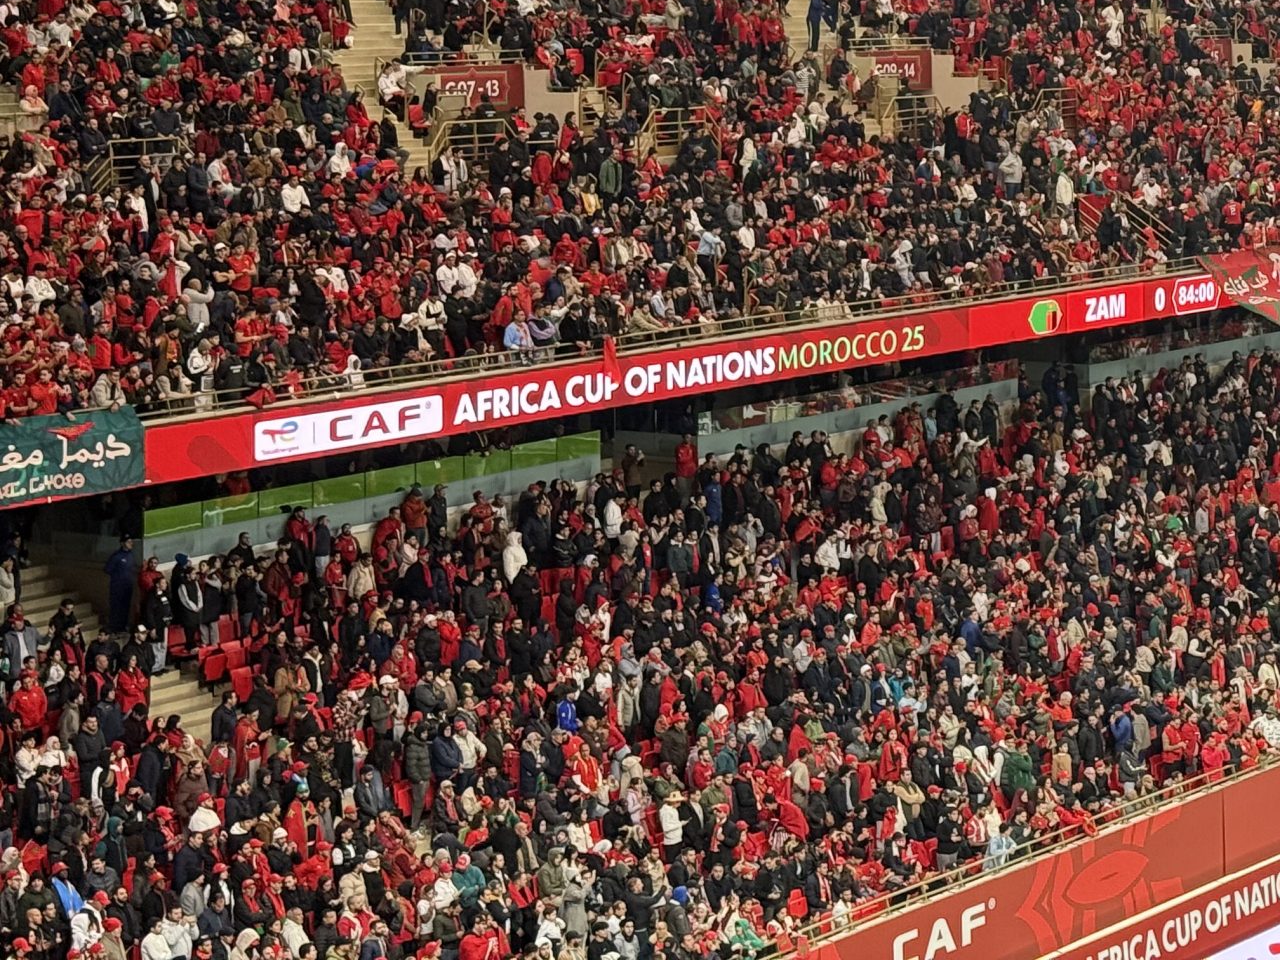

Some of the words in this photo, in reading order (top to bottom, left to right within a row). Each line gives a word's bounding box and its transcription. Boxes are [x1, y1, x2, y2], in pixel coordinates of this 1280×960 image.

[1085, 292, 1126, 323] ZAM
[1154, 287, 1166, 312] 0
[1178, 281, 1215, 306] 84:00
[329, 404, 421, 442] CAF
[453, 380, 562, 425] AFRICA
[624, 363, 662, 397] OF
[665, 346, 776, 391] NATIONS
[777, 329, 898, 372] MOROCCO
[901, 325, 925, 352] 25
[1161, 908, 1203, 953] CUP
[1204, 894, 1232, 933] OF
